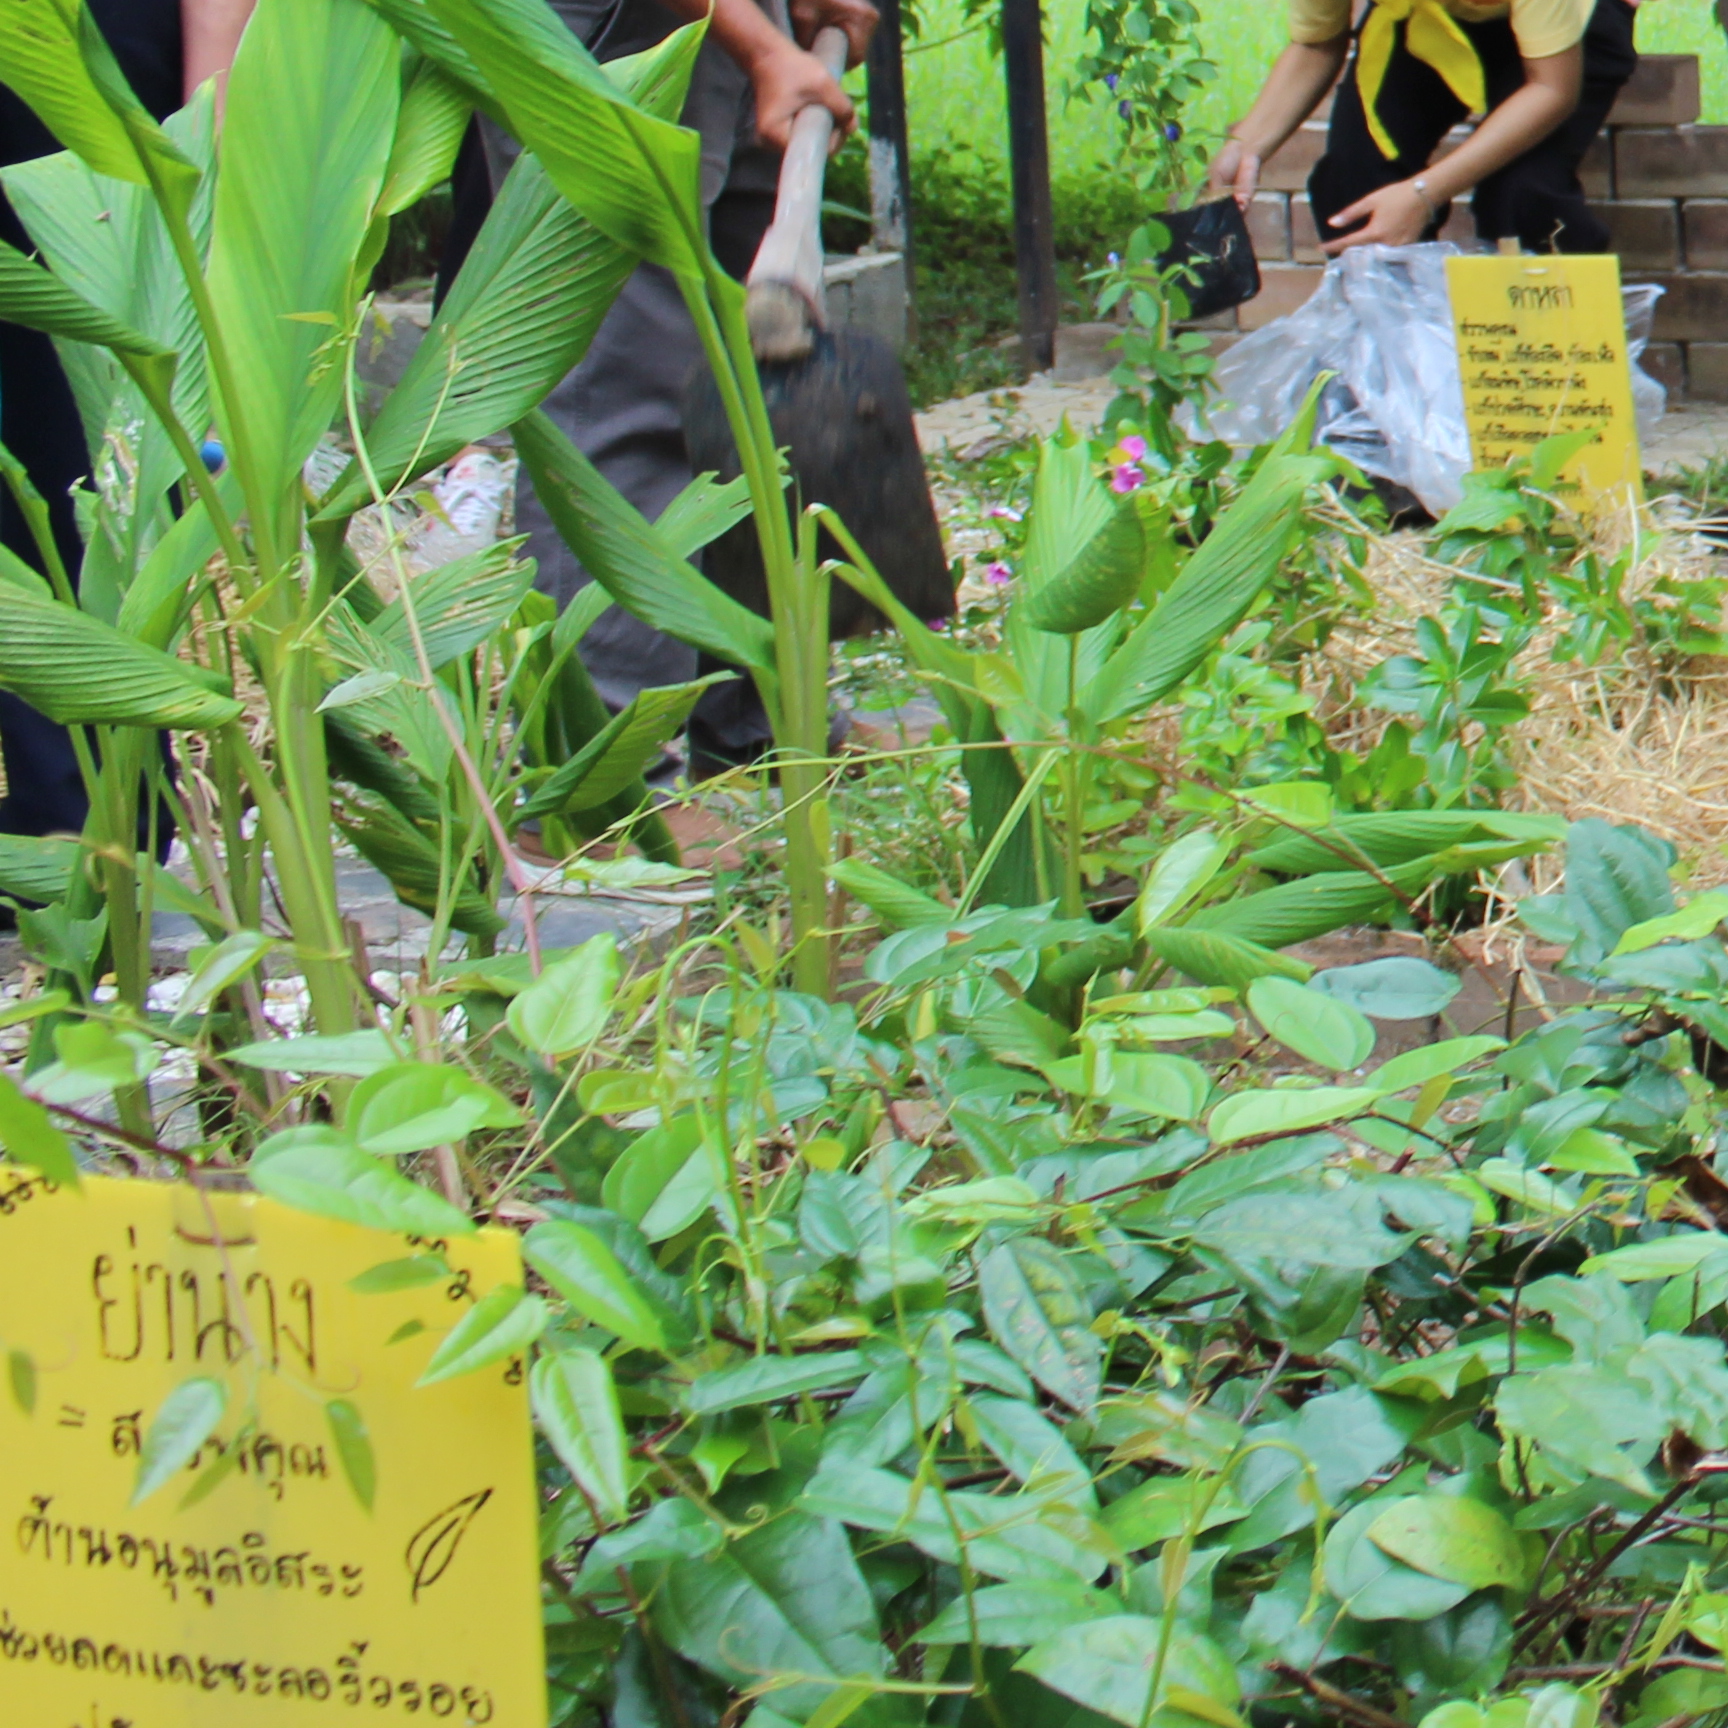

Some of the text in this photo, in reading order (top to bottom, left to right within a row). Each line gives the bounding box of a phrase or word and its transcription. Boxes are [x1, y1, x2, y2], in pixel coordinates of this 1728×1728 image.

[92, 1225, 317, 1373] ย่านาง
[17, 1494, 364, 1608] ต้านอนุมูลอิสระ
